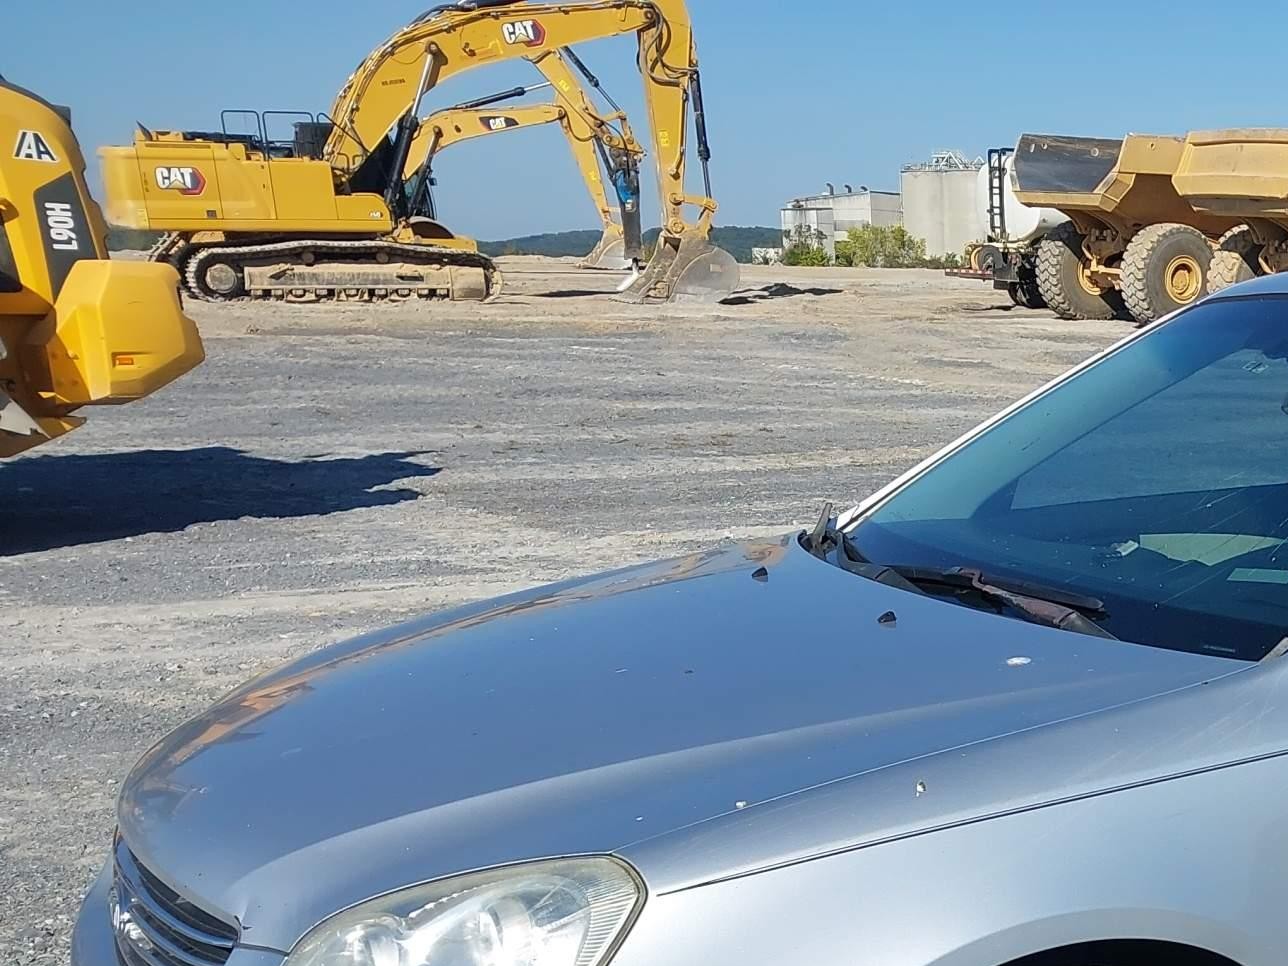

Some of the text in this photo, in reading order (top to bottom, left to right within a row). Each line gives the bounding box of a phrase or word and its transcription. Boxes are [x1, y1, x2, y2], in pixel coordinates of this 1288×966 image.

[502, 20, 535, 44] CAT
[489, 117, 506, 130] CAT
[155, 167, 193, 189] CAT
[44, 202, 79, 251] L90H
